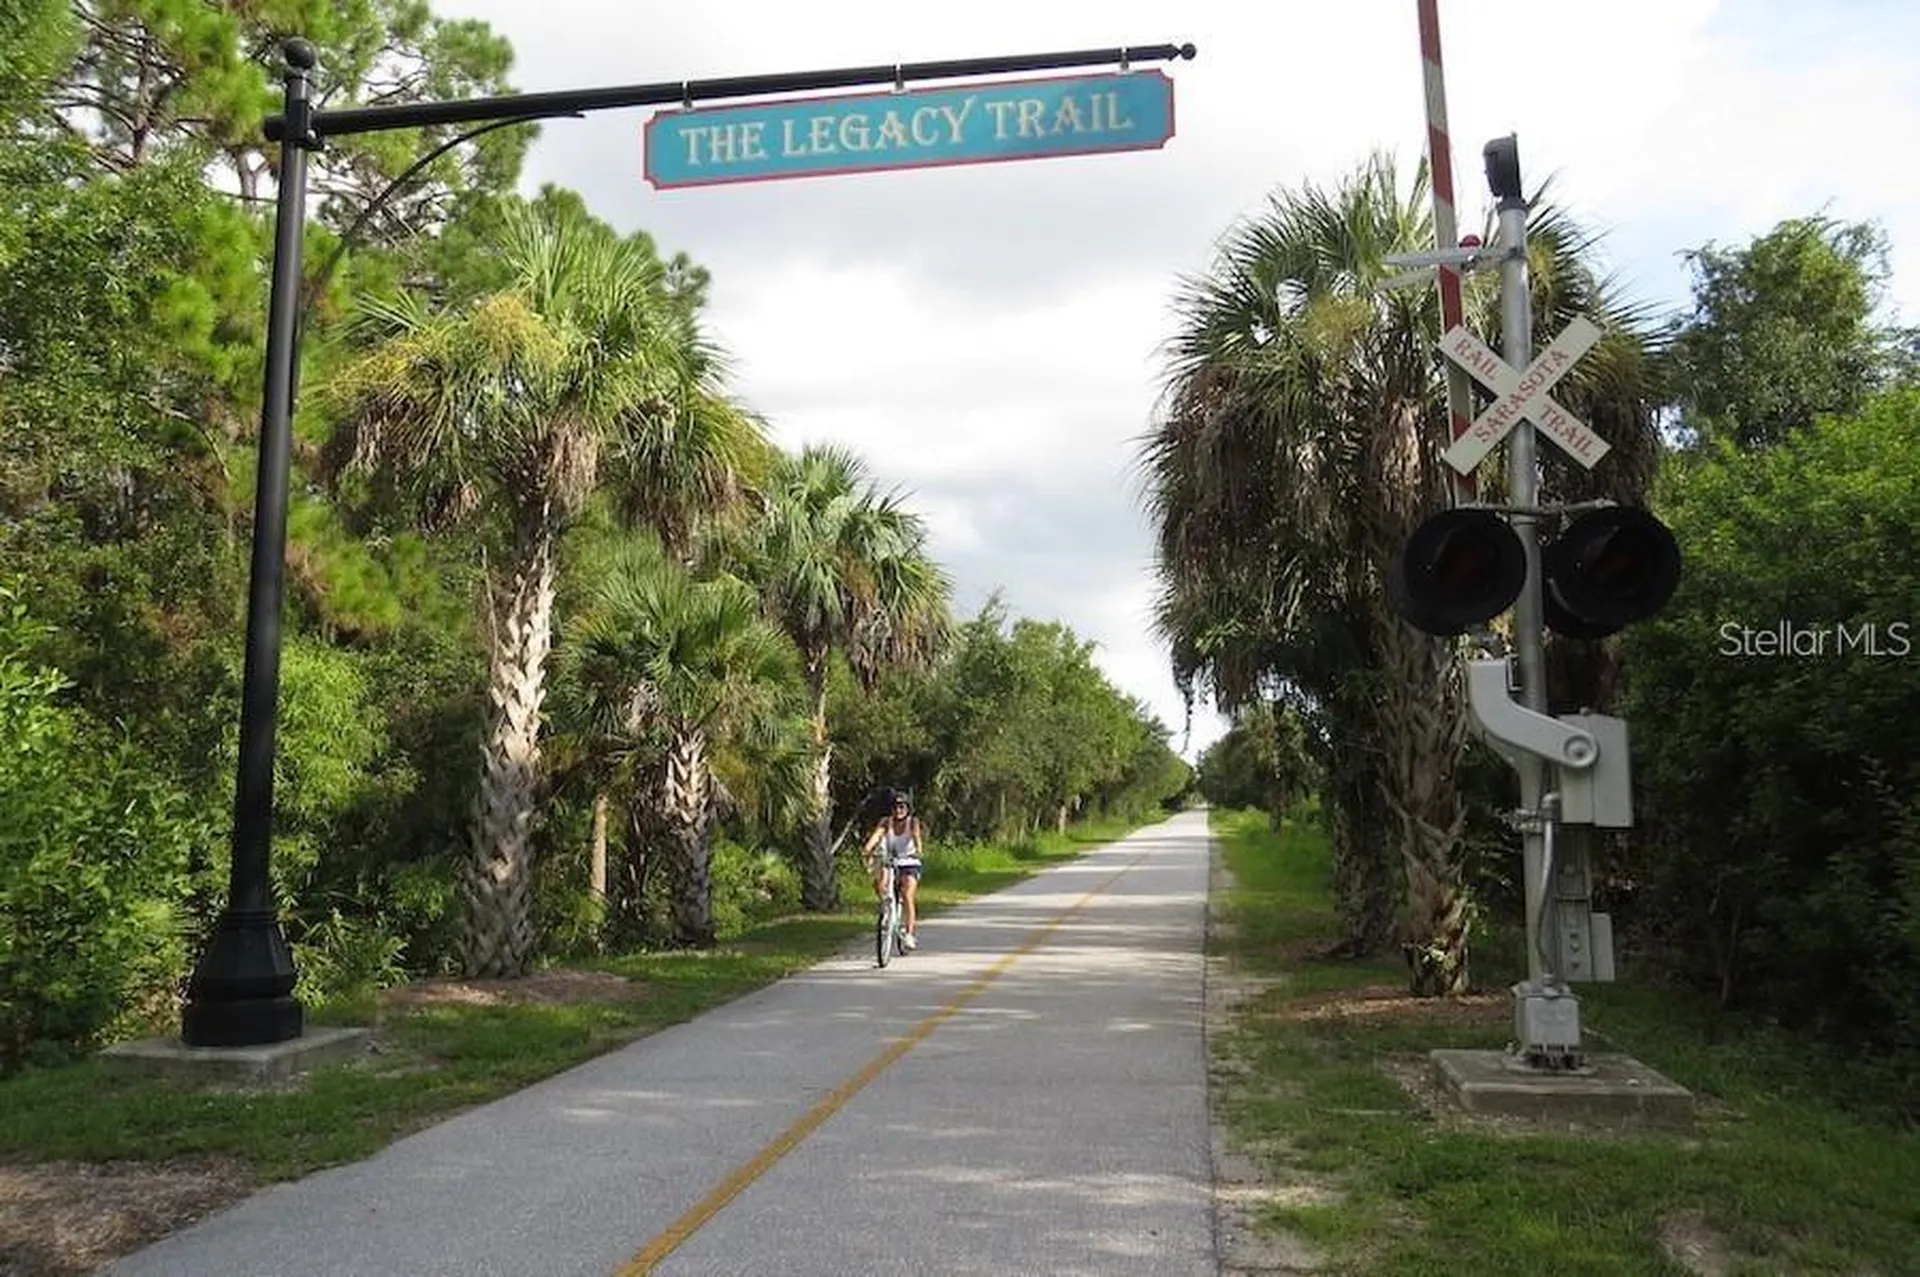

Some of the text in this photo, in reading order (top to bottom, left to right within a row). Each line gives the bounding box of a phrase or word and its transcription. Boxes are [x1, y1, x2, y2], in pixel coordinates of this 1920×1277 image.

[679, 91, 1134, 165] THE LEGACY TRAIL
[1454, 338, 1595, 458] RAIL TRAIL
[1474, 349, 1570, 443] SARASOTA
